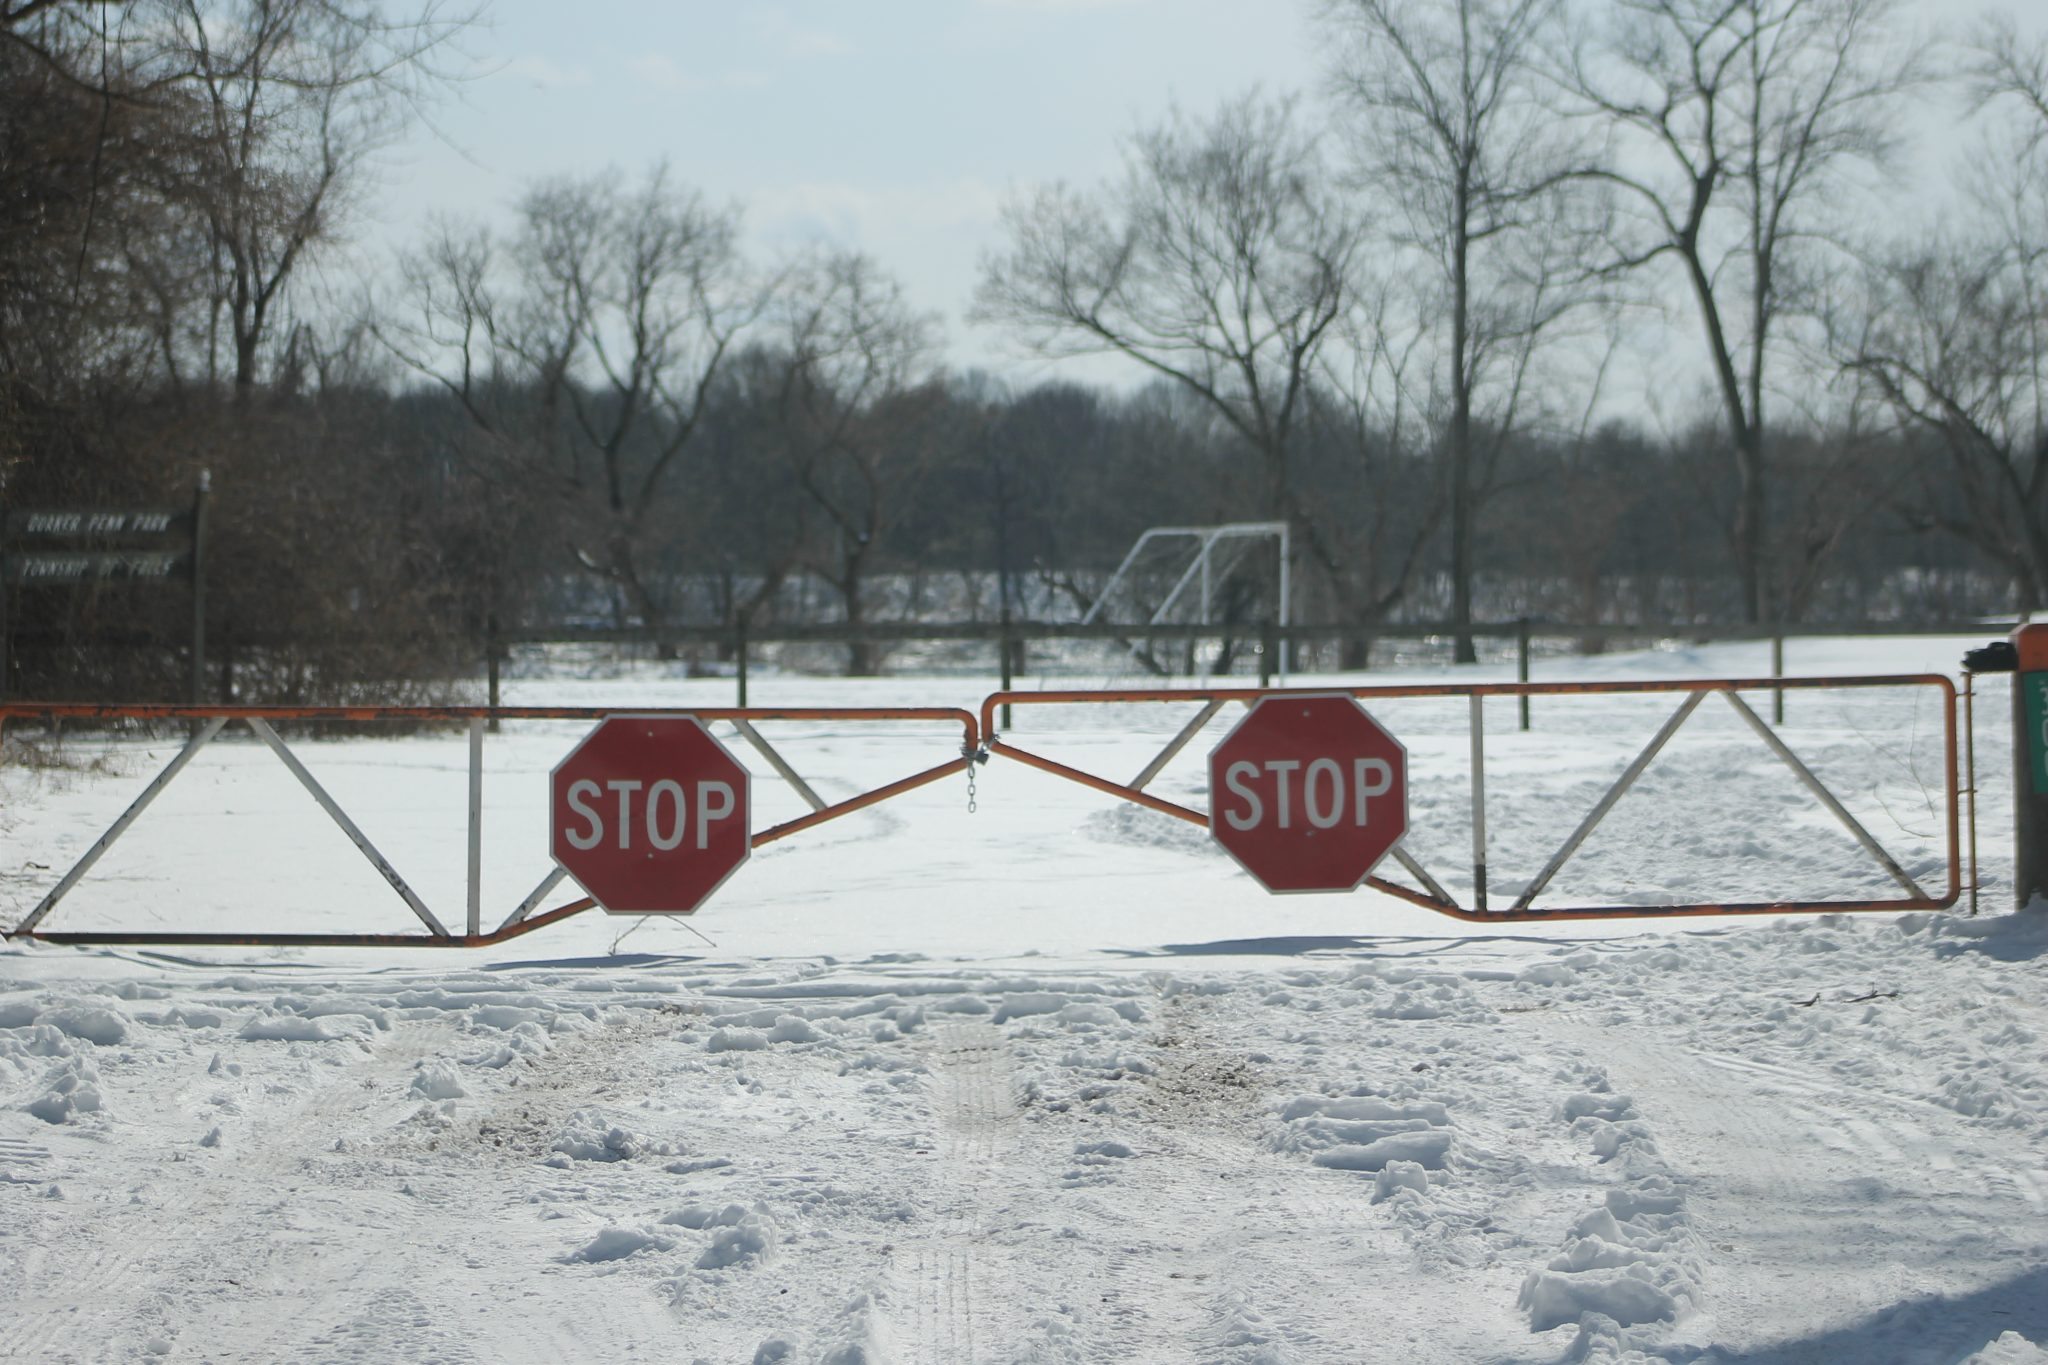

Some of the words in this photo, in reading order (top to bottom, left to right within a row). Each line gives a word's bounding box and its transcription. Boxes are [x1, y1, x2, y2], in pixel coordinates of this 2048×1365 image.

[132, 513, 170, 532] PARK
[23, 558, 88, 577] TOWNSHIP
[98, 557, 120, 577] OF
[565, 779, 735, 851] STOP
[1224, 757, 1393, 832] STOP
